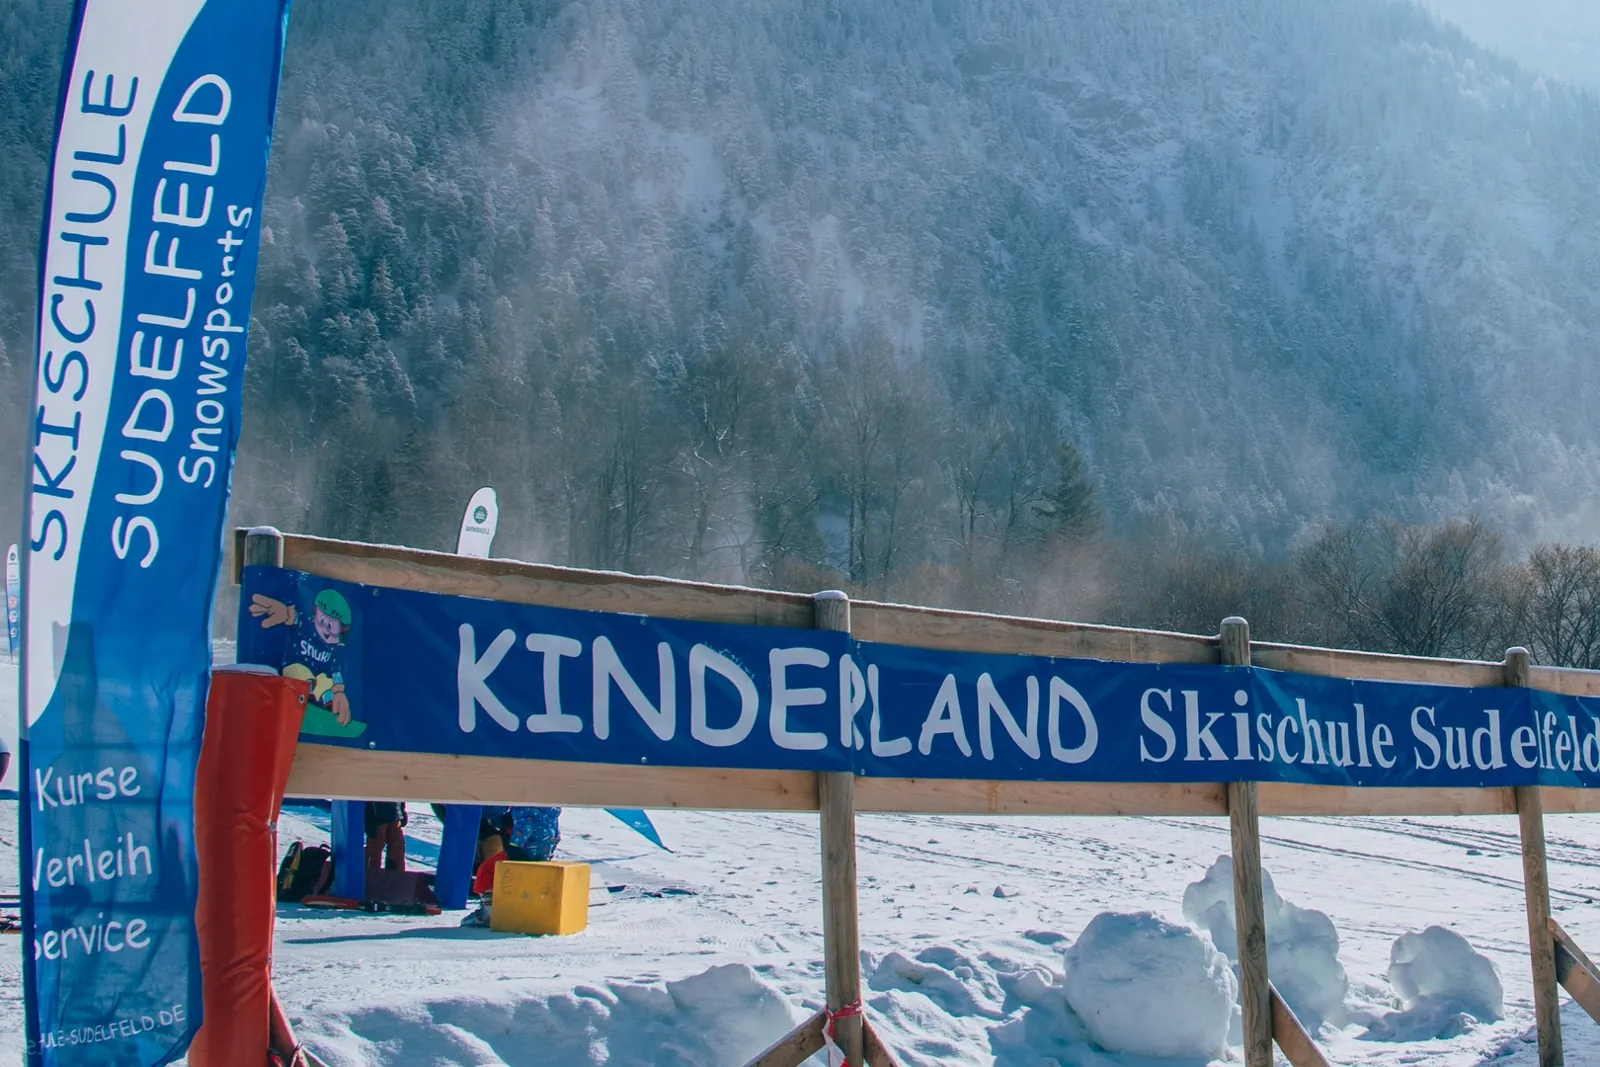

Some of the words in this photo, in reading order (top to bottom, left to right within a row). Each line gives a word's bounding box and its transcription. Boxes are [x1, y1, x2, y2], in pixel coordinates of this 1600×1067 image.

[30, 69, 140, 561] SKISCHULE
[110, 72, 233, 569] SUDELFELD
[177, 204, 253, 488] Snowsports
[35, 765, 141, 812] Kurse
[457, 622, 1099, 765] KINDERLAND
[1139, 686, 1397, 769] Skischule
[1410, 704, 1600, 773] Sudelfeld
